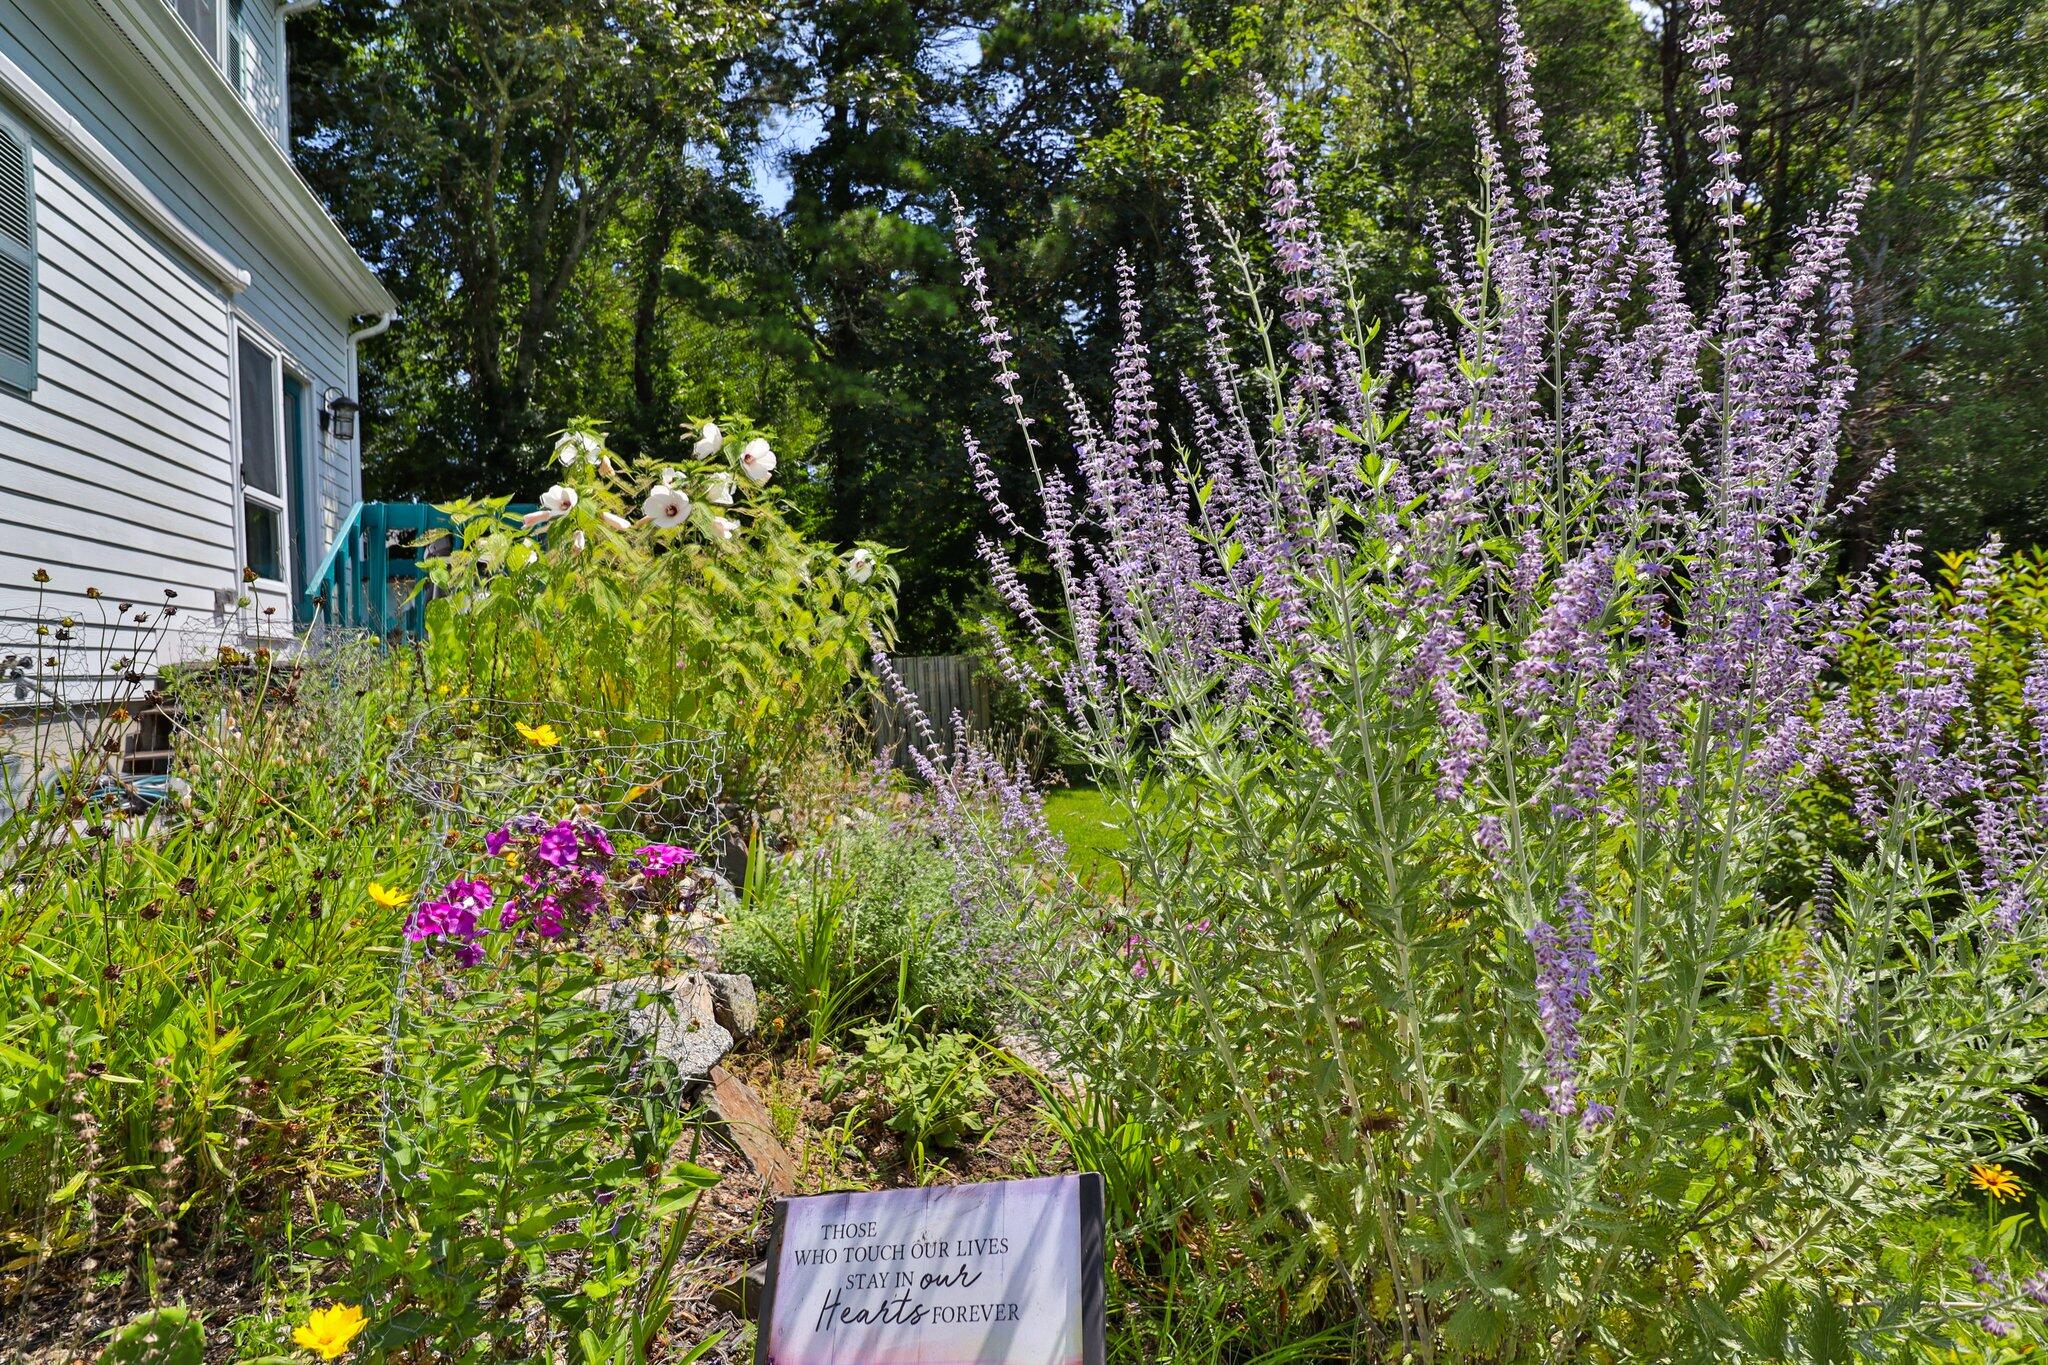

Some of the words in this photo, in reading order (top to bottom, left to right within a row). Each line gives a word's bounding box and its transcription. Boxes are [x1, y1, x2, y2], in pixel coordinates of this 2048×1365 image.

[821, 1221, 878, 1241] THOSE
[794, 1248, 838, 1266] WHO
[842, 1243, 905, 1263] TOUCH
[911, 1241, 949, 1259] OUR
[956, 1237, 1009, 1257] LIVES
[845, 1271, 889, 1290] STAY
[894, 1271, 914, 1288] IN
[919, 1263, 982, 1290] our
[815, 1287, 931, 1332] Hearts
[931, 1303, 1020, 1324] FOREVER
